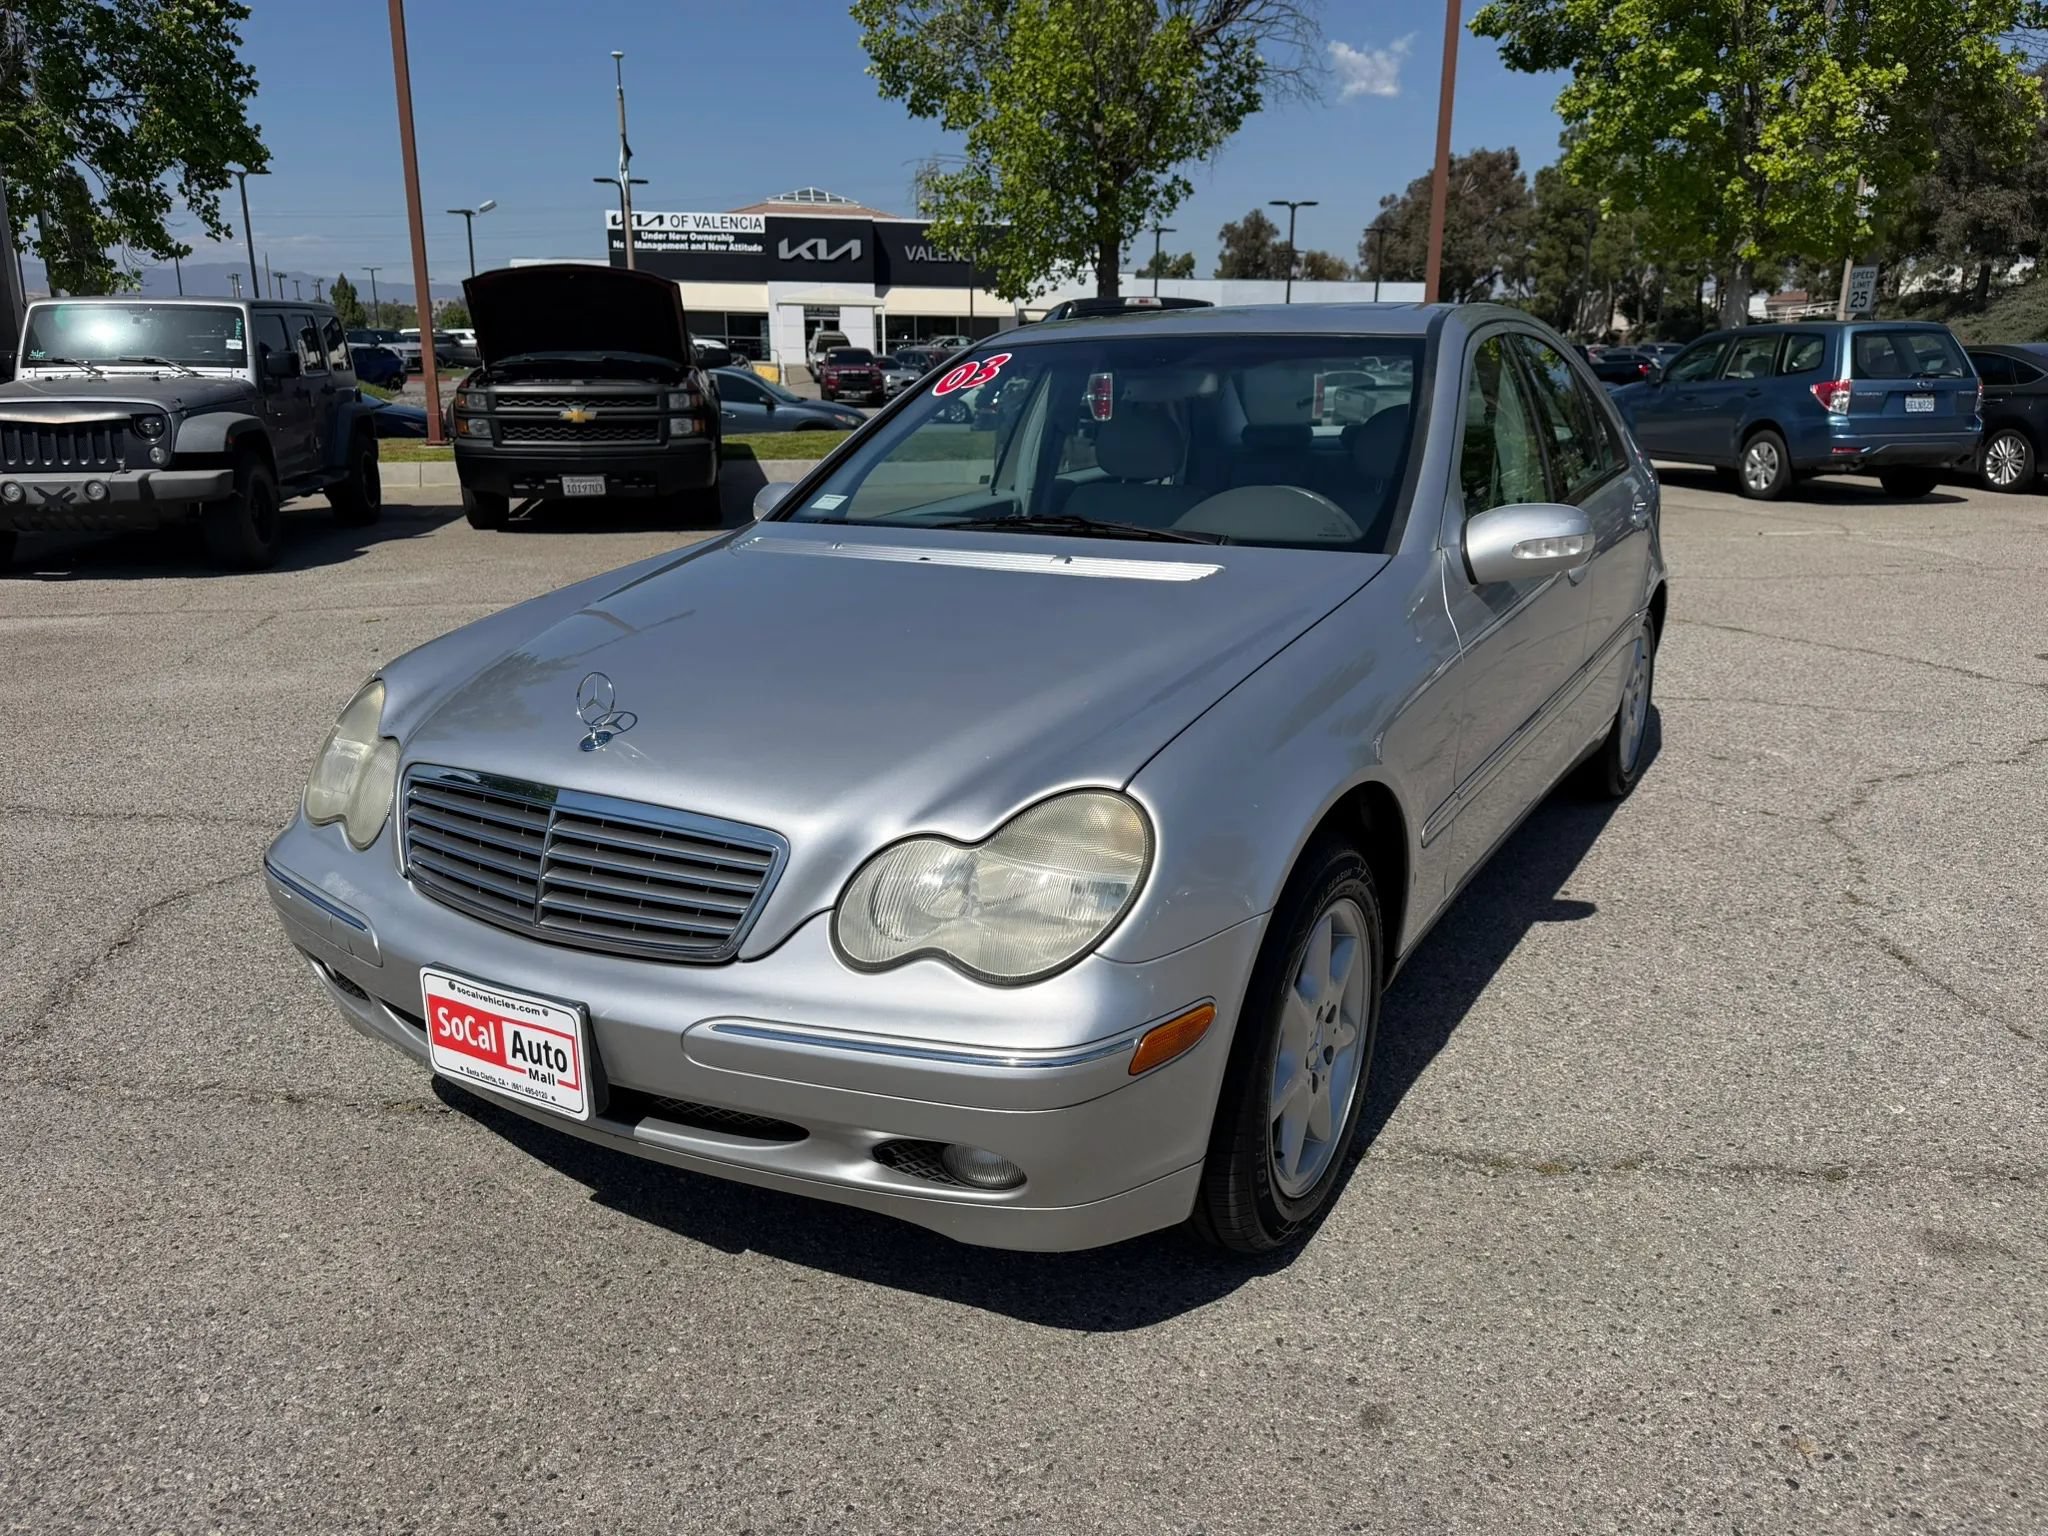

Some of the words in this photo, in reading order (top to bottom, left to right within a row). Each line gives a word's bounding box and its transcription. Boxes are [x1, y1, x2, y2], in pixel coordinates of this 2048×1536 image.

[670, 214, 688, 228] OF
[693, 215, 763, 230] VALENCIA
[641, 231, 667, 240] Under
[669, 232, 688, 240] New
[690, 233, 735, 243] Ownership
[634, 240, 689, 251] Management
[692, 242, 706, 250] and
[708, 243, 727, 251] New
[728, 243, 763, 252] Attitude
[778, 237, 862, 261] KIA
[1852, 271, 1875, 280] SPEED
[1852, 280, 1871, 289] LIMIT
[1850, 291, 1868, 308] 25
[932, 353, 1012, 396] 03
[457, 986, 541, 1016] socalvehicles.com
[437, 1006, 498, 1053] SoCal
[512, 1030, 568, 1073] Auto
[466, 1066, 480, 1078] Santa
[528, 1067, 555, 1086] Mall
